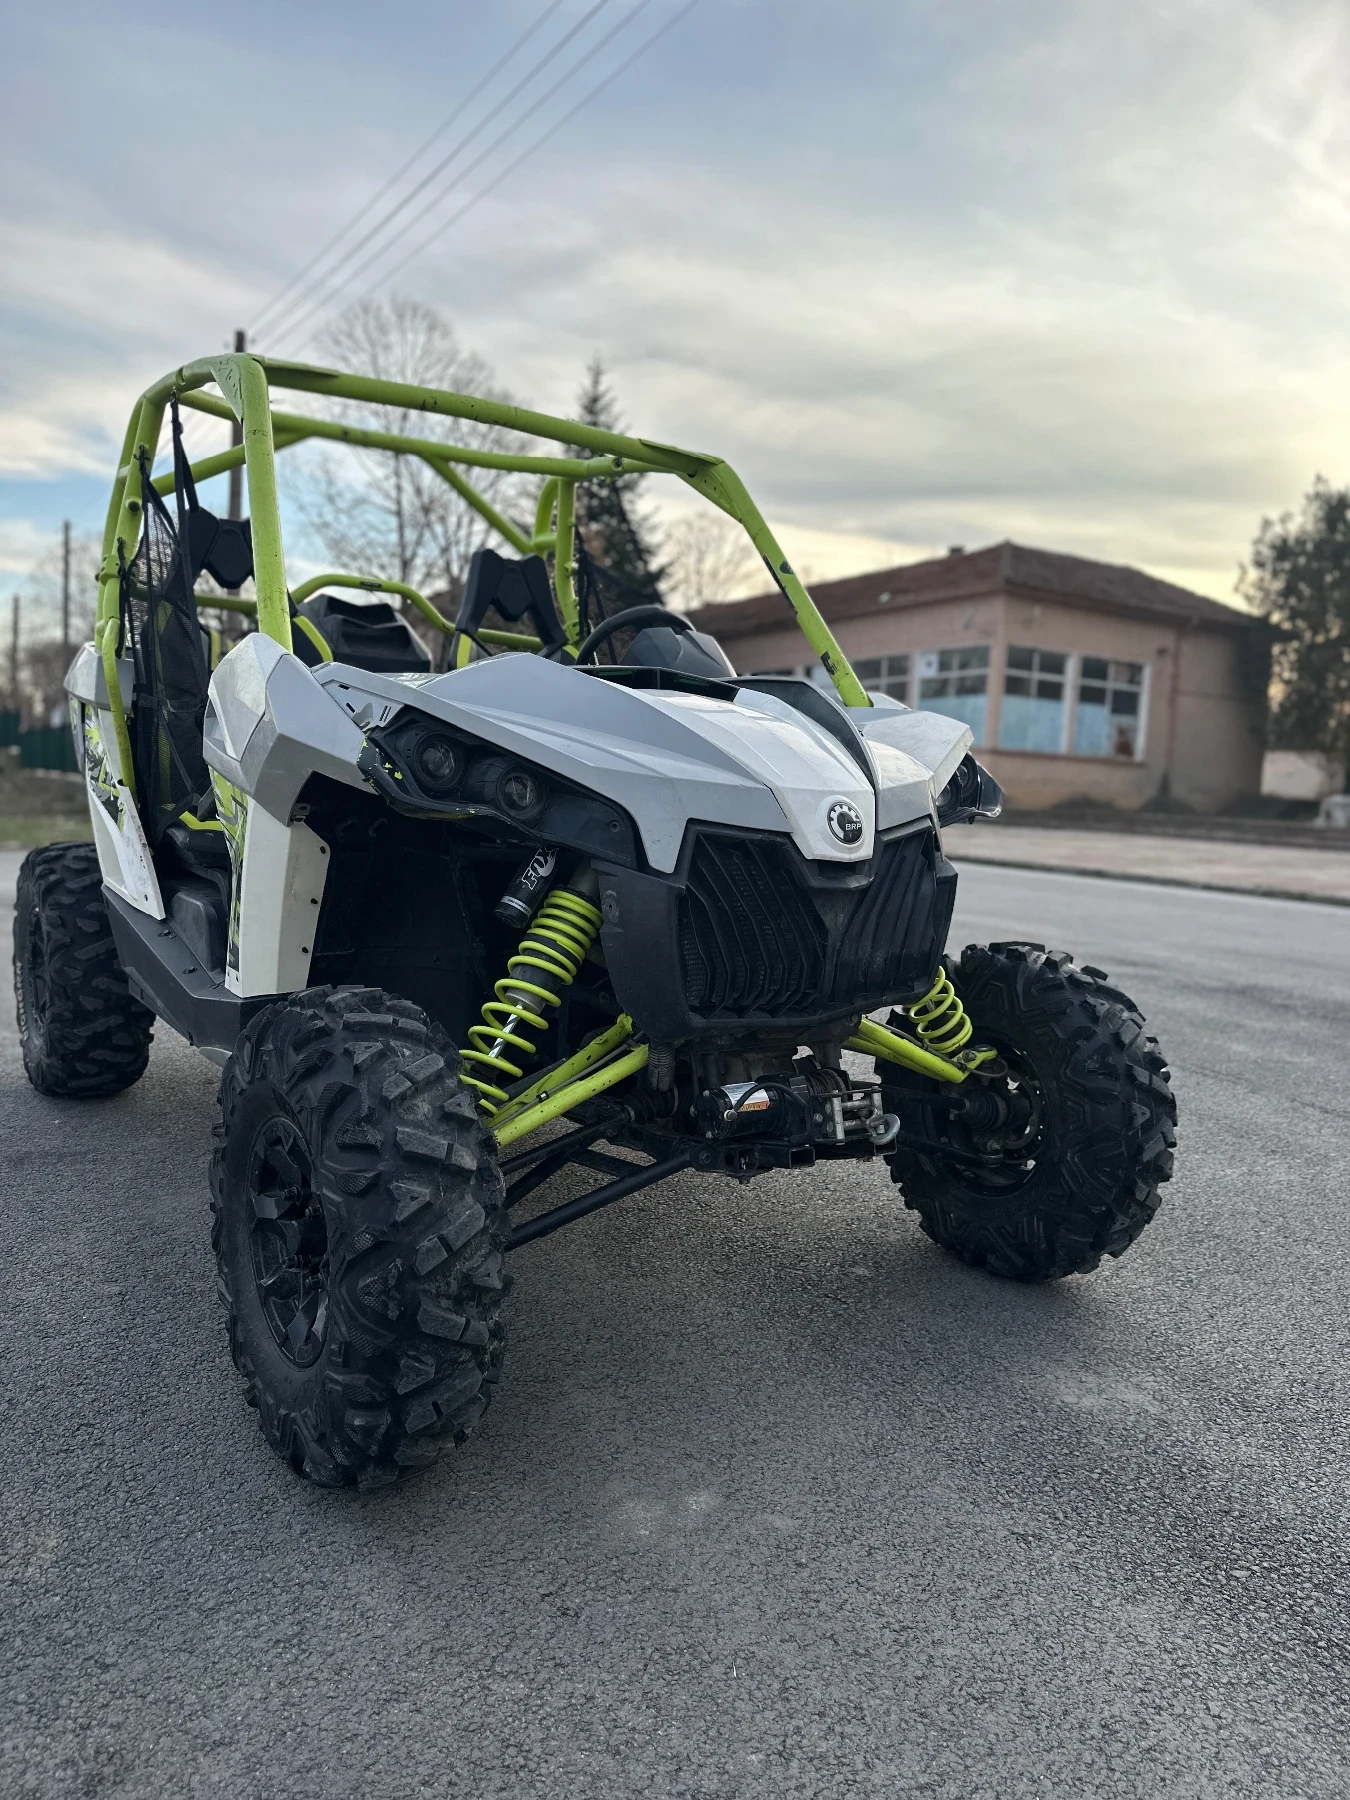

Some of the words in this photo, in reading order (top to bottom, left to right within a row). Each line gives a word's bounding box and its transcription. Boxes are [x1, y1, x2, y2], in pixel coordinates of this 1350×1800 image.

[845, 823, 862, 831] BRP
[521, 843, 559, 890] FOX
[16, 962, 29, 1040] BIGHORN
